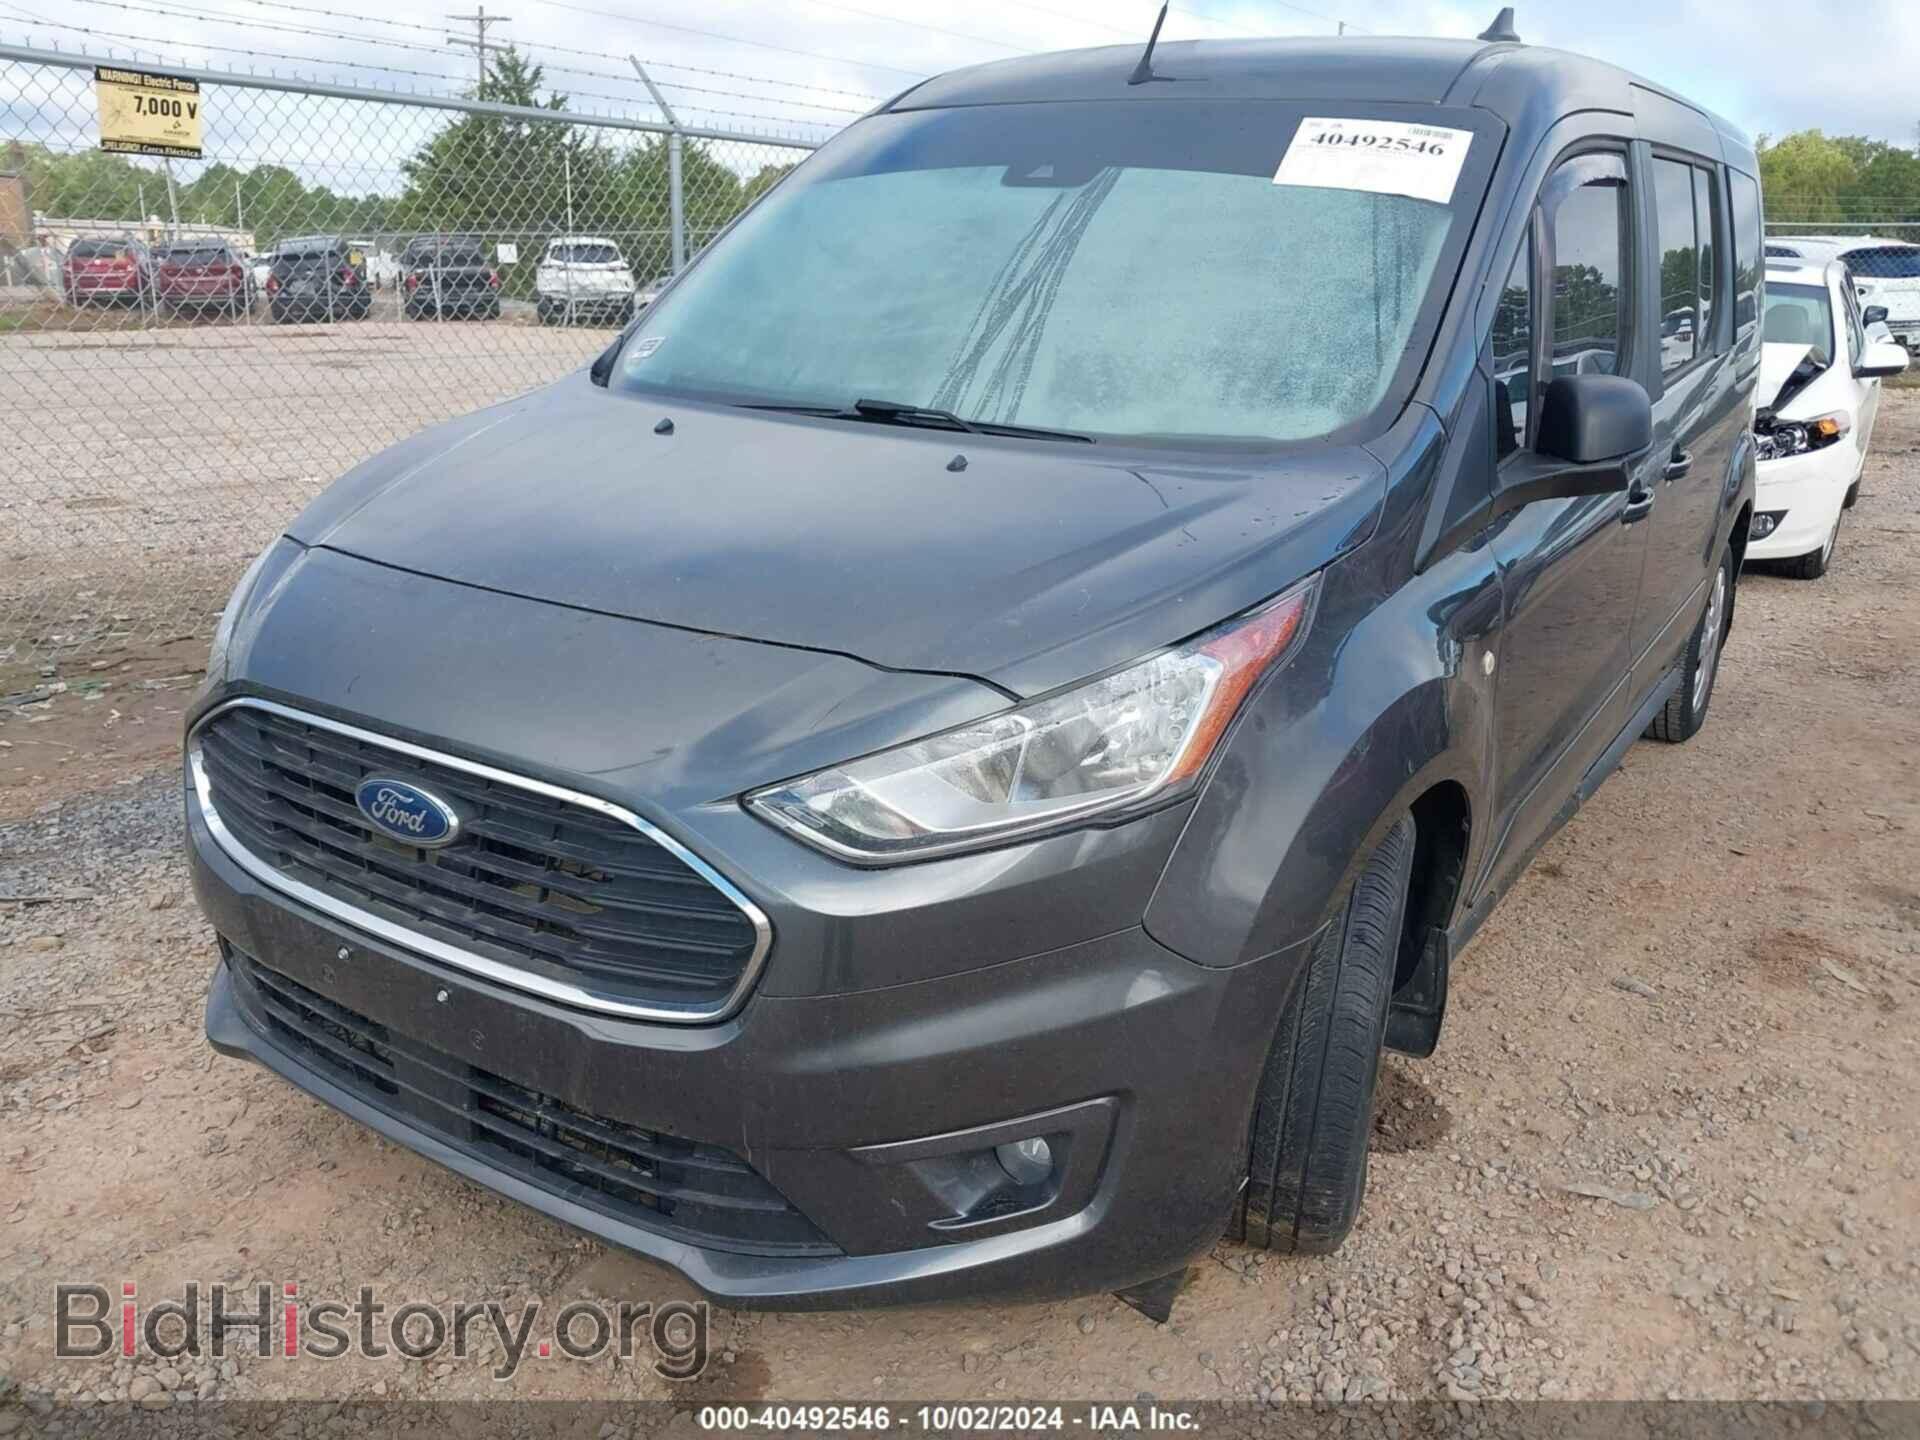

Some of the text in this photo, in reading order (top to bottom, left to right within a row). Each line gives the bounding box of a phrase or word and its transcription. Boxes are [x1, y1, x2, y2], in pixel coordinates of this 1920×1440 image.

[133, 95, 198, 120] 7,000 V
[1311, 131, 1446, 156] 40492546
[371, 787, 427, 832] Ford
